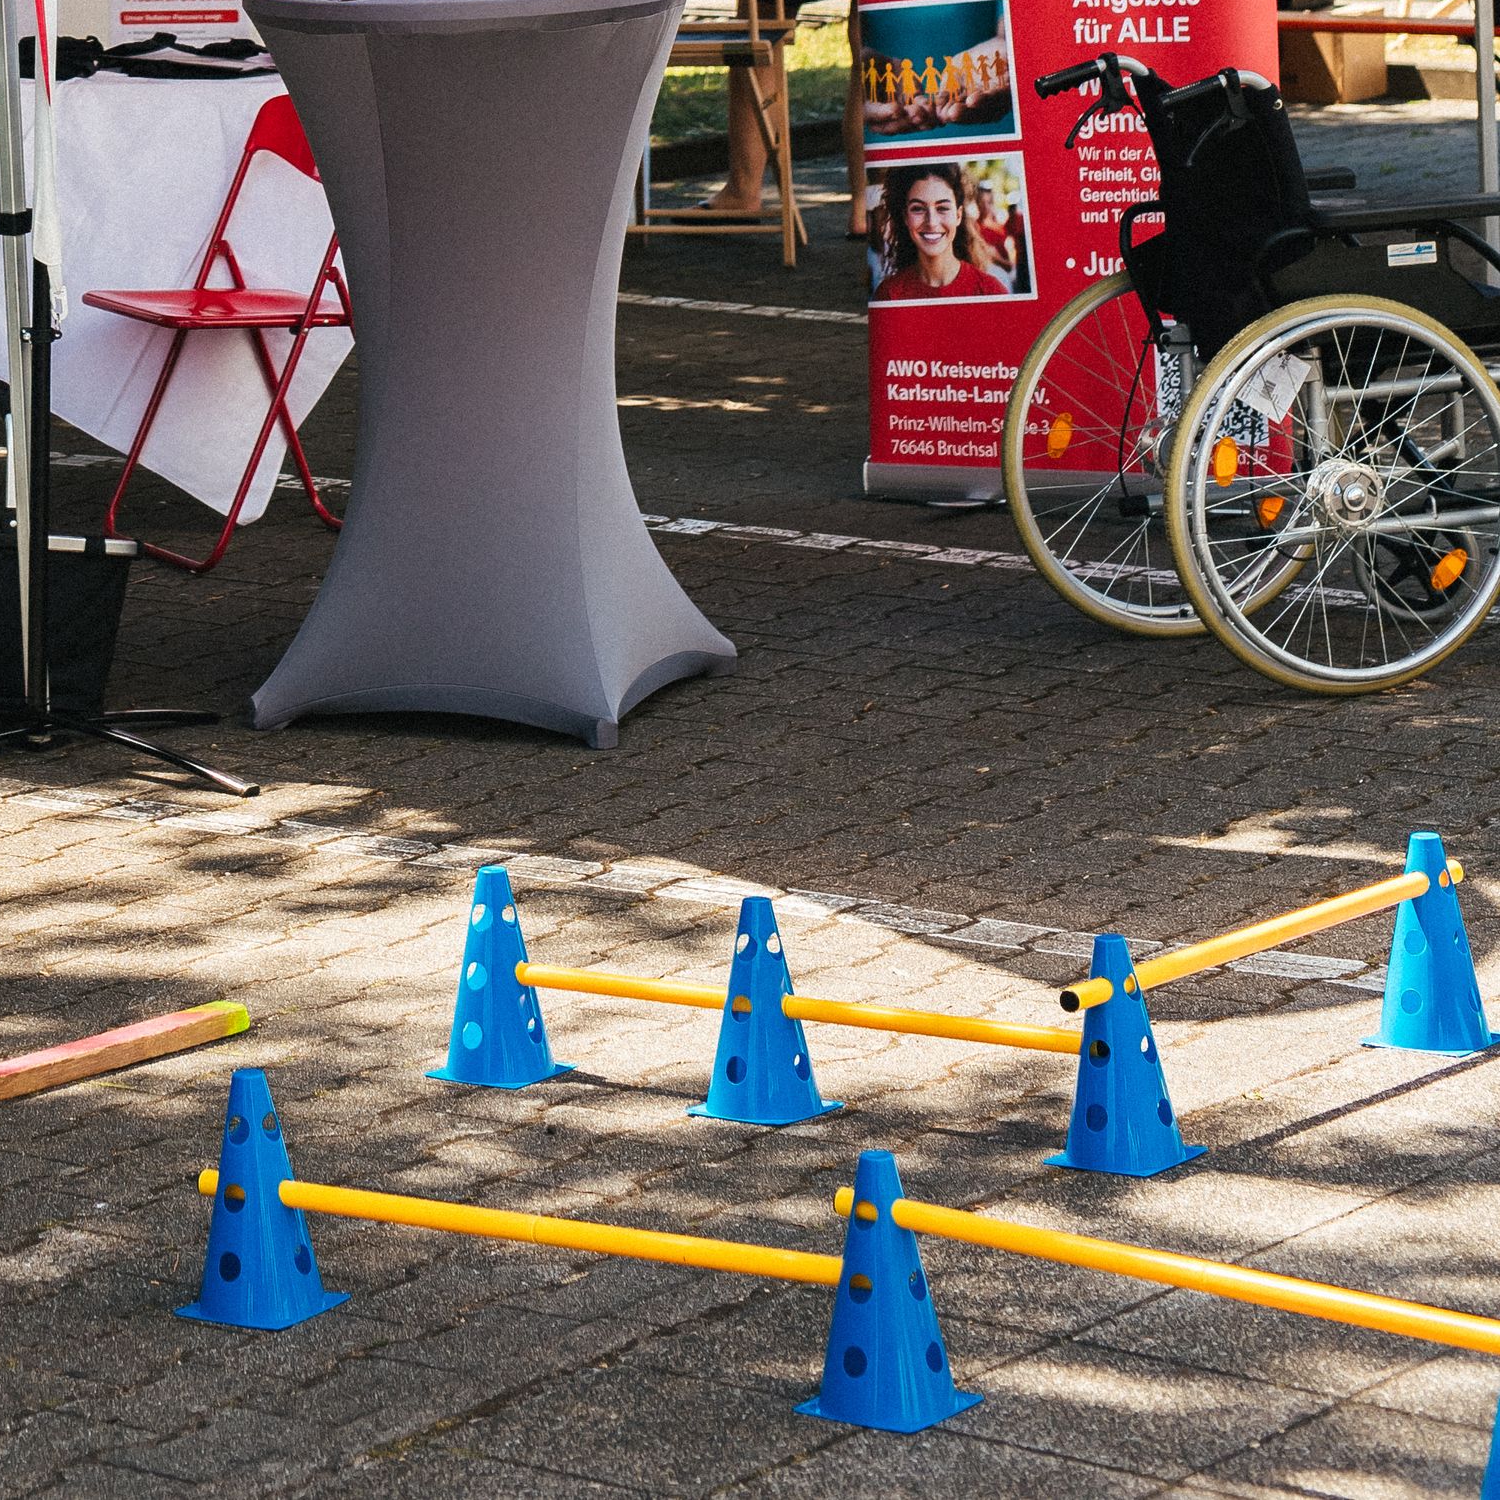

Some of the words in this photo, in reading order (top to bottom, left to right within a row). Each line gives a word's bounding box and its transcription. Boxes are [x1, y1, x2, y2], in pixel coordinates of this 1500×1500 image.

[1074, 18, 1113, 44] für
[1117, 16, 1190, 43] ALLE
[1078, 146, 1102, 161] Wir
[1104, 146, 1116, 161] in
[1119, 146, 1142, 161] der
[1078, 166, 1137, 183] Freiheit,
[1080, 187, 1160, 203] Gerechtigk
[1081, 208, 1108, 223] und
[886, 359, 927, 377] AWO
[930, 360, 1019, 380] Kreisverba
[890, 438, 935, 456] 76646
[937, 440, 998, 458] Bruchsal
